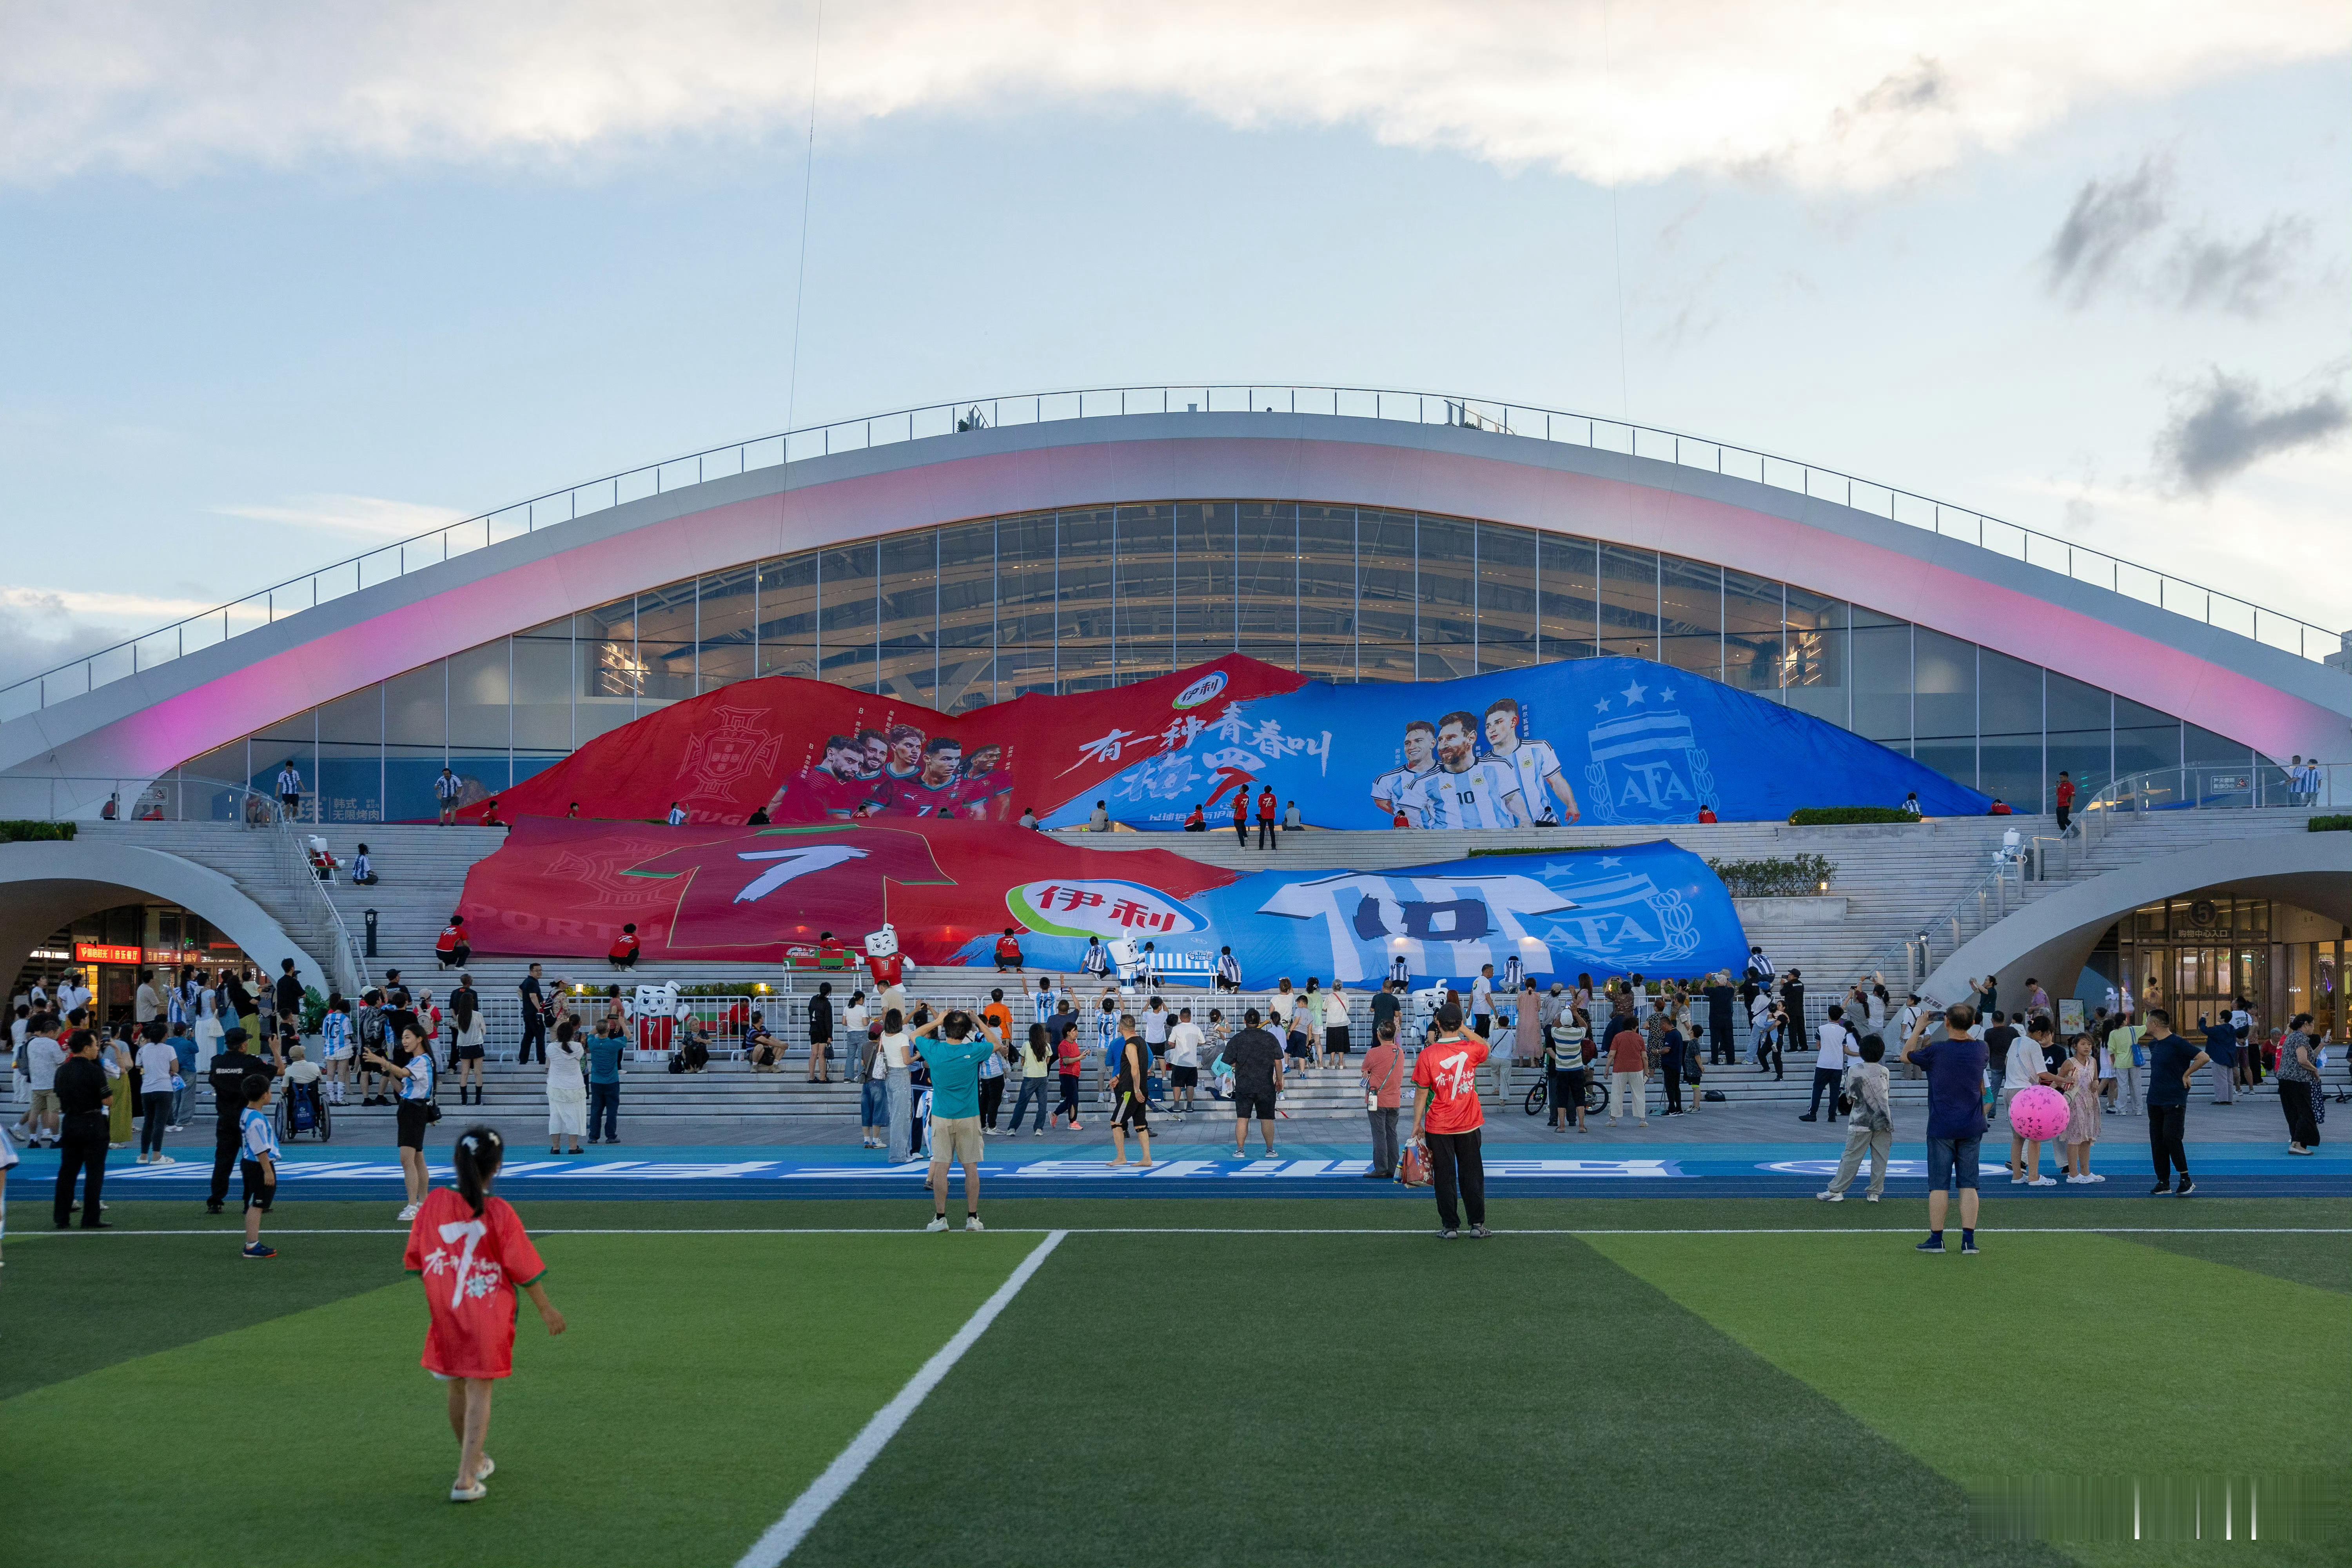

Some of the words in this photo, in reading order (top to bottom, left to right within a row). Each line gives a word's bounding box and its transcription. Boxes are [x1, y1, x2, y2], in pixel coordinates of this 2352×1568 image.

[1181, 679, 1219, 702] 伊利
[1475, 746, 1481, 757] 梅西
[1616, 760, 1695, 810] AFA
[1456, 790, 1475, 805] 10
[333, 810, 379, 820] 无限烤肉
[916, 806, 933, 817] 7
[733, 845, 874, 904] 7
[1035, 885, 1176, 932] 伊利
[1352, 893, 1499, 944] 10
[1542, 912, 1661, 953] AFA
[115, 950, 138, 960] 音乐餐厅
[882, 960, 889, 970] 7
[647, 1022, 656, 1035] 7
[1439, 1051, 1468, 1101] 7
[438, 1220, 487, 1309] 7
